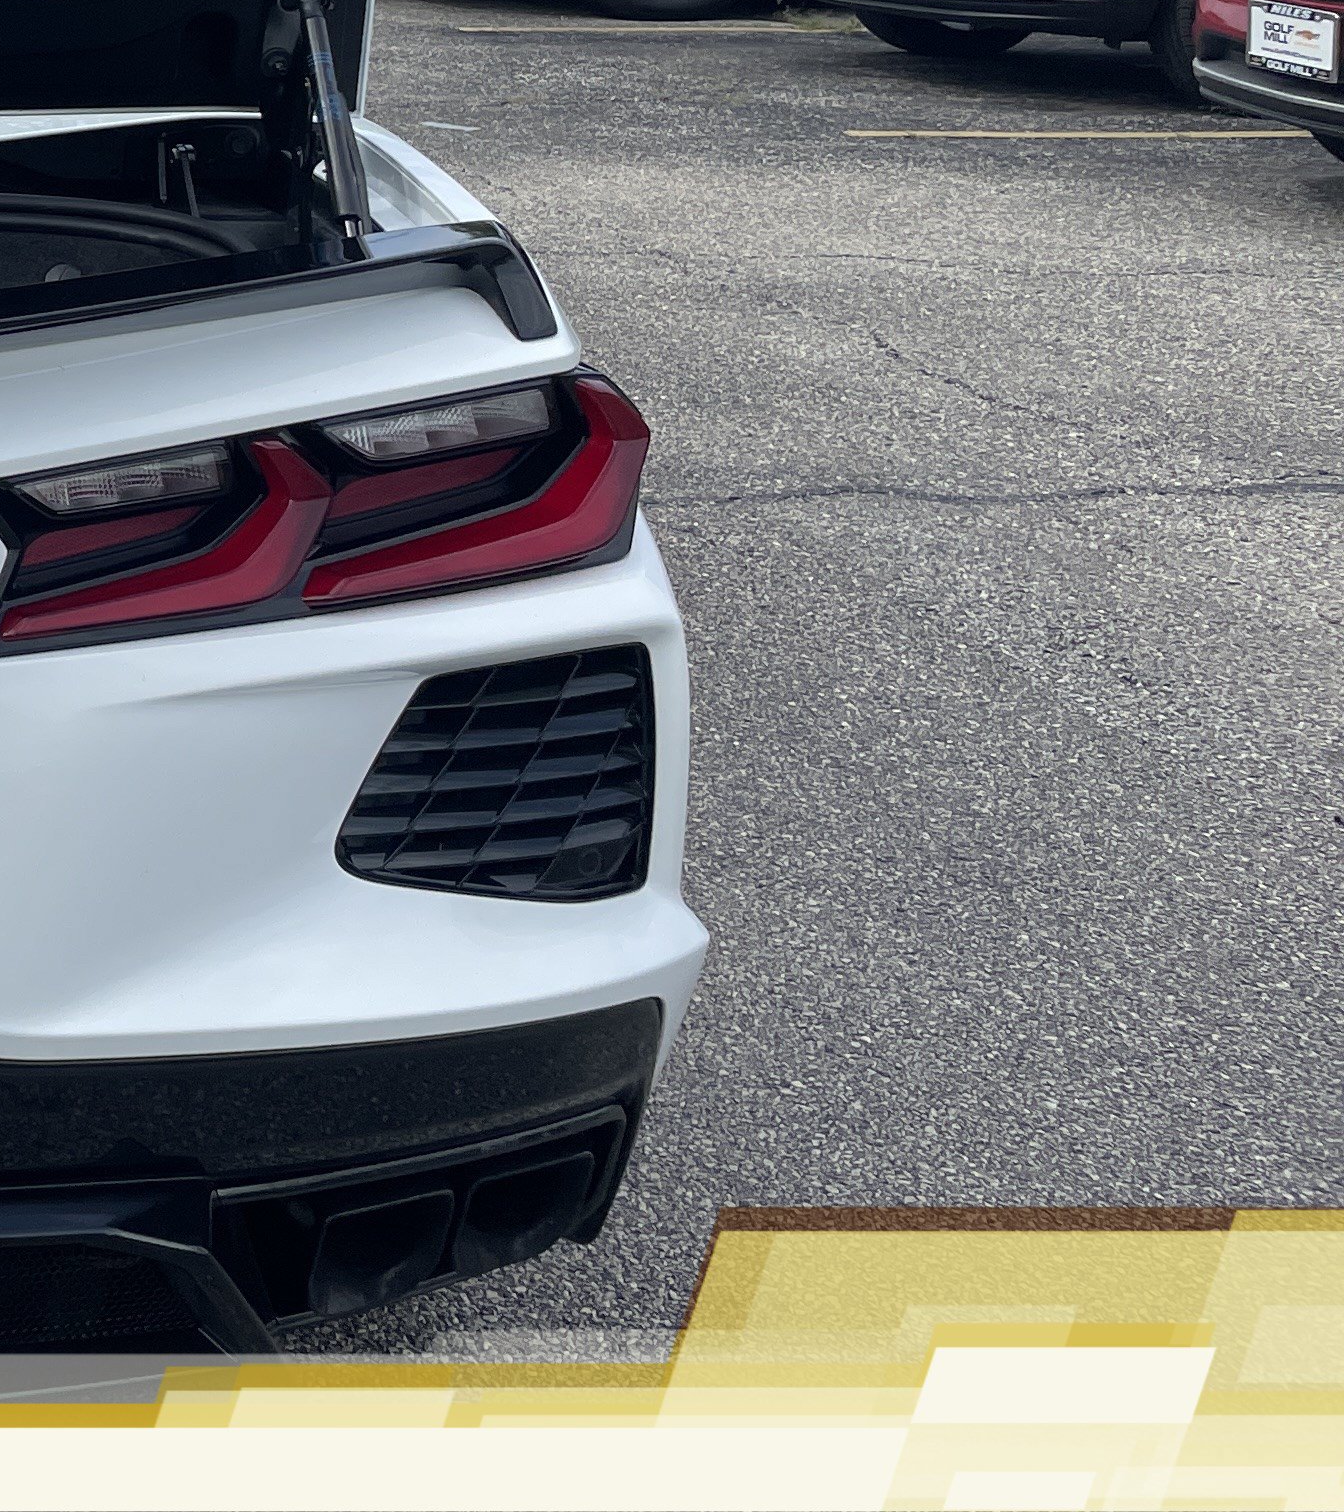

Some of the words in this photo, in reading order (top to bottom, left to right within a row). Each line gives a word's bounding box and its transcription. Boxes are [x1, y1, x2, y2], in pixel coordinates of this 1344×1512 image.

[1264, 20, 1294, 35] GOLF
[1263, 31, 1288, 45] MILL
[1266, 59, 1290, 73] GOLF
[1289, 63, 1313, 78] MILL
